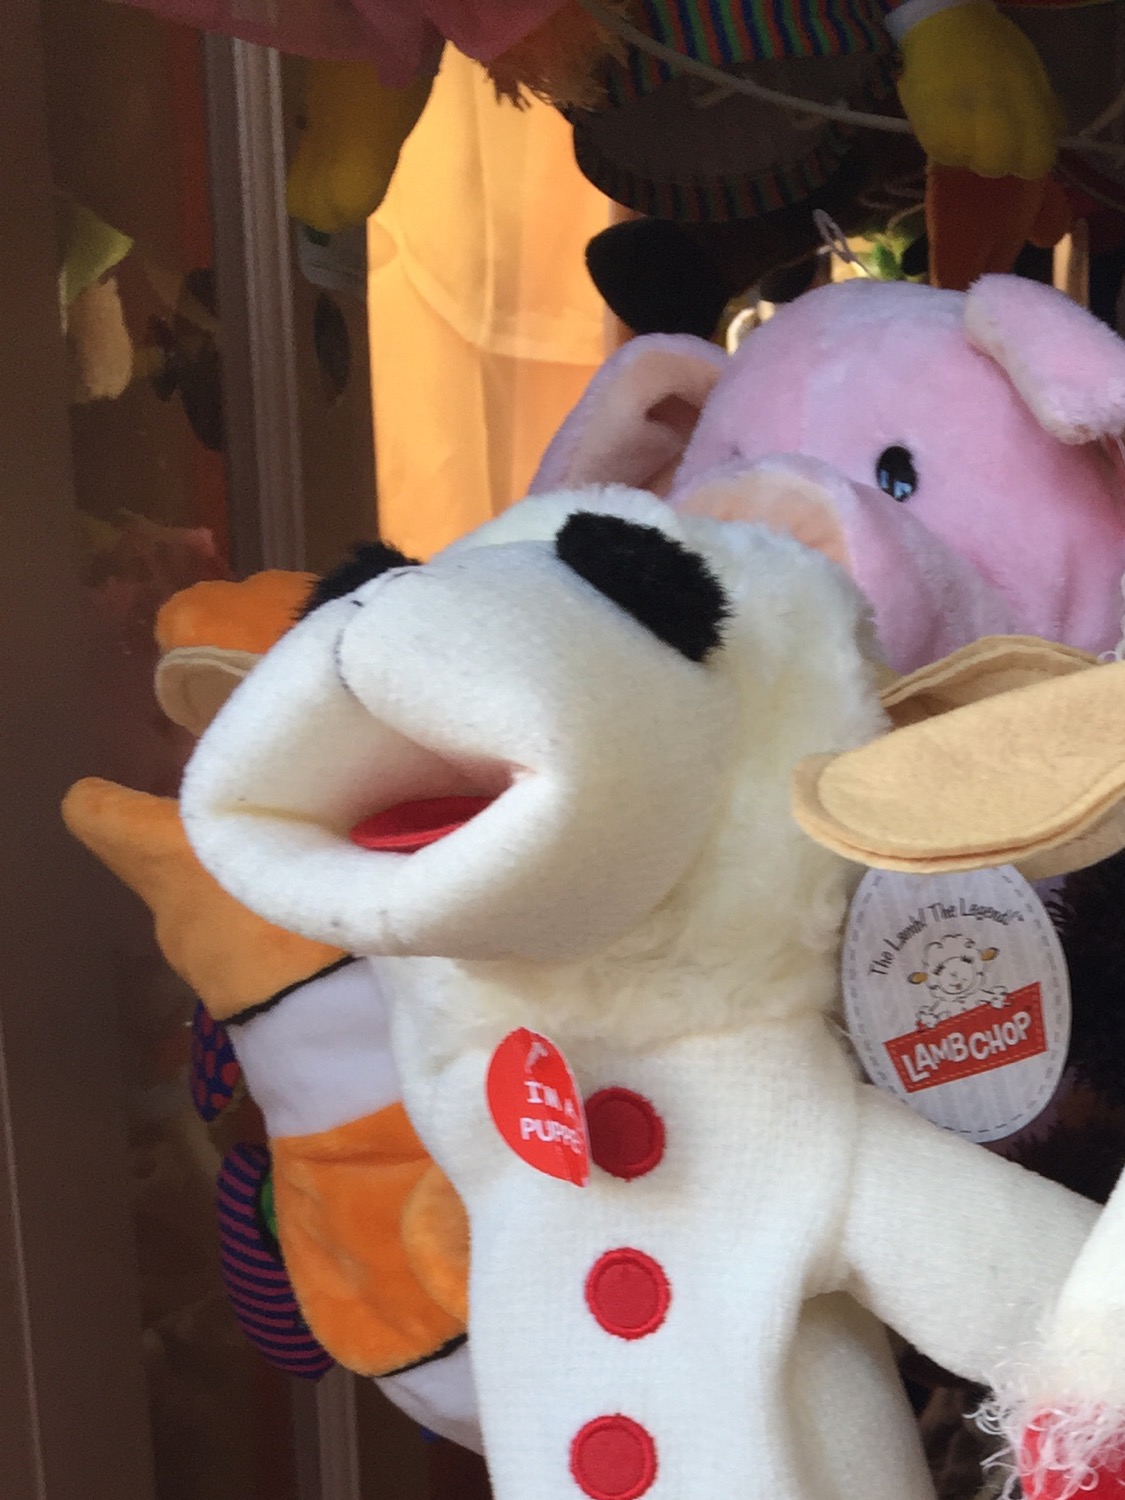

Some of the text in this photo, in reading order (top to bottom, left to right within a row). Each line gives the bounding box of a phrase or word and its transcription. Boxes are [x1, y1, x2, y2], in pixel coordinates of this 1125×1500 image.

[867, 951, 895, 977] The
[927, 902, 957, 922] The
[520, 1117, 583, 1154] PUPPE
